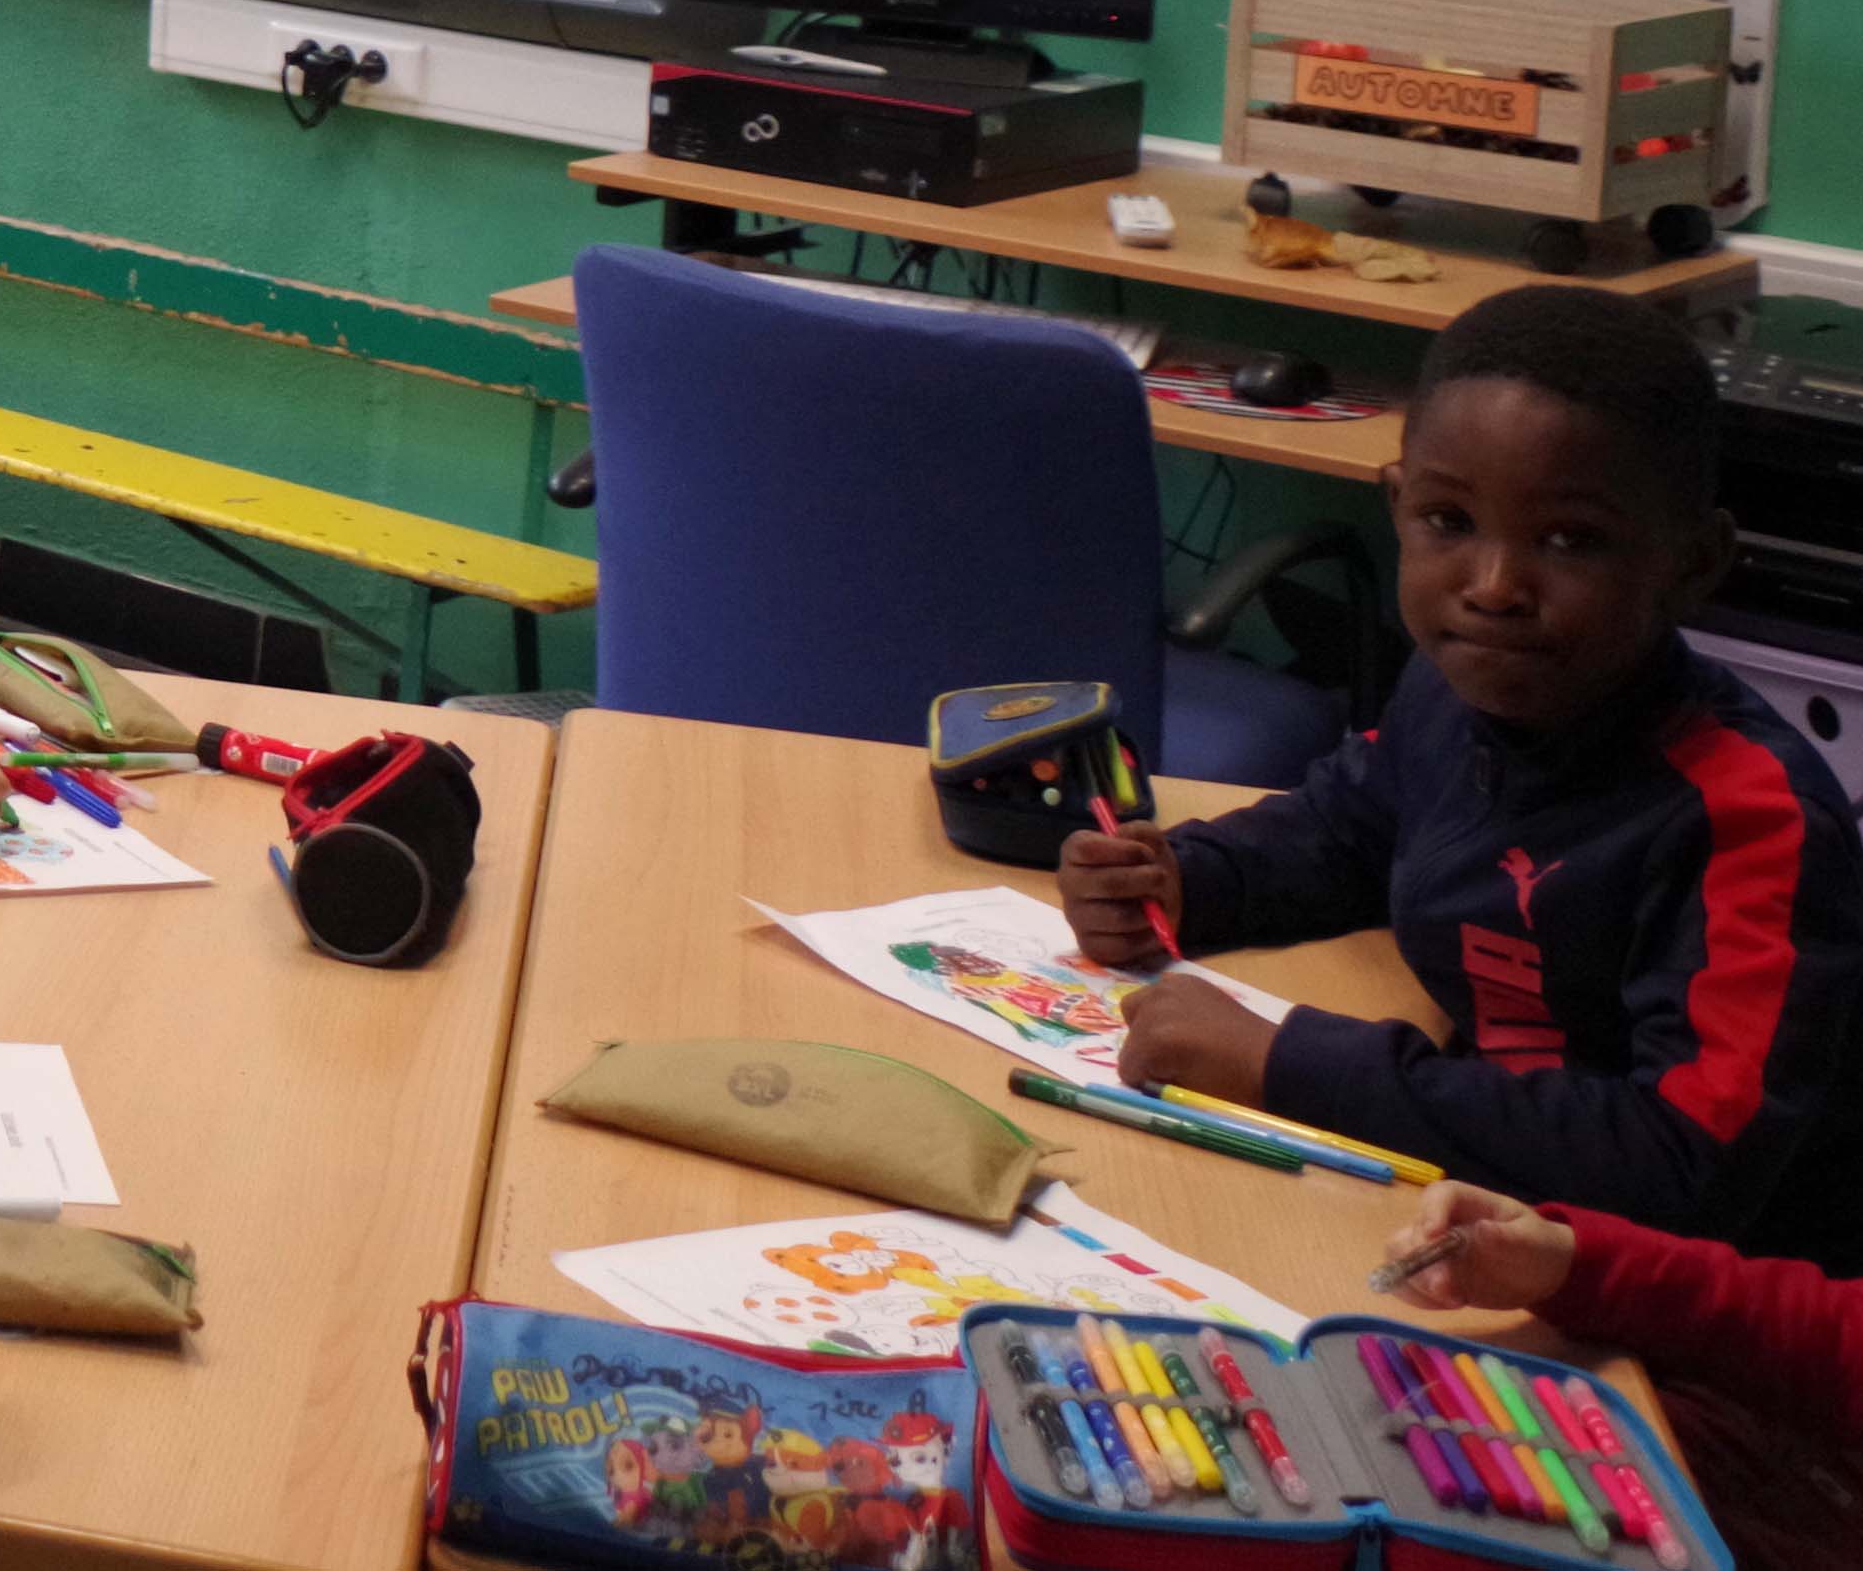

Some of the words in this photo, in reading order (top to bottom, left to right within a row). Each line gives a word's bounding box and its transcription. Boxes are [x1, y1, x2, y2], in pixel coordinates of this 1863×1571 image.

[1308, 65, 1516, 121] AUTOMNE
[491, 1367, 571, 1406] PAW
[477, 1390, 633, 1459] PATROL!
